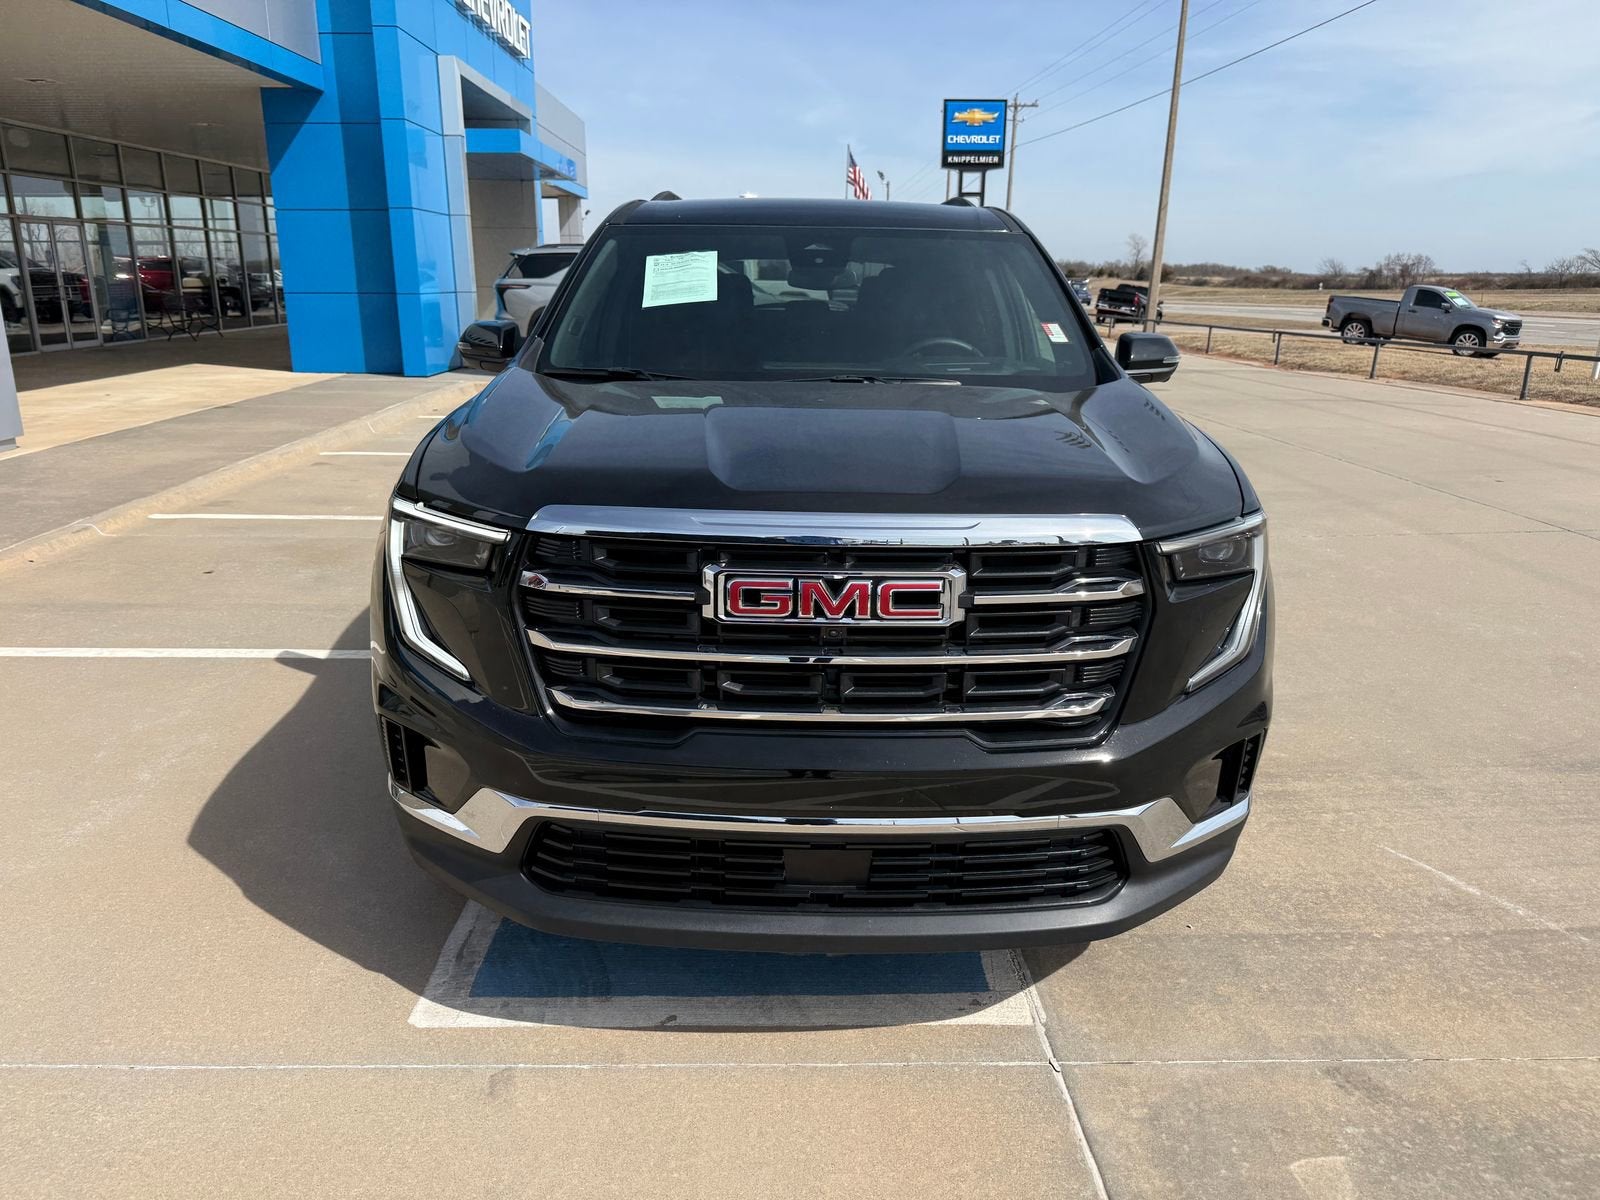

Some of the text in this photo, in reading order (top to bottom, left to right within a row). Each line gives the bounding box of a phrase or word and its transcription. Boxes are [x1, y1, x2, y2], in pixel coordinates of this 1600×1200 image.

[463, 0, 531, 59] EVROLET
[947, 135, 1001, 144] CHEVROLET
[947, 155, 999, 164] KNIPPELMIER
[726, 578, 945, 620] GMC
